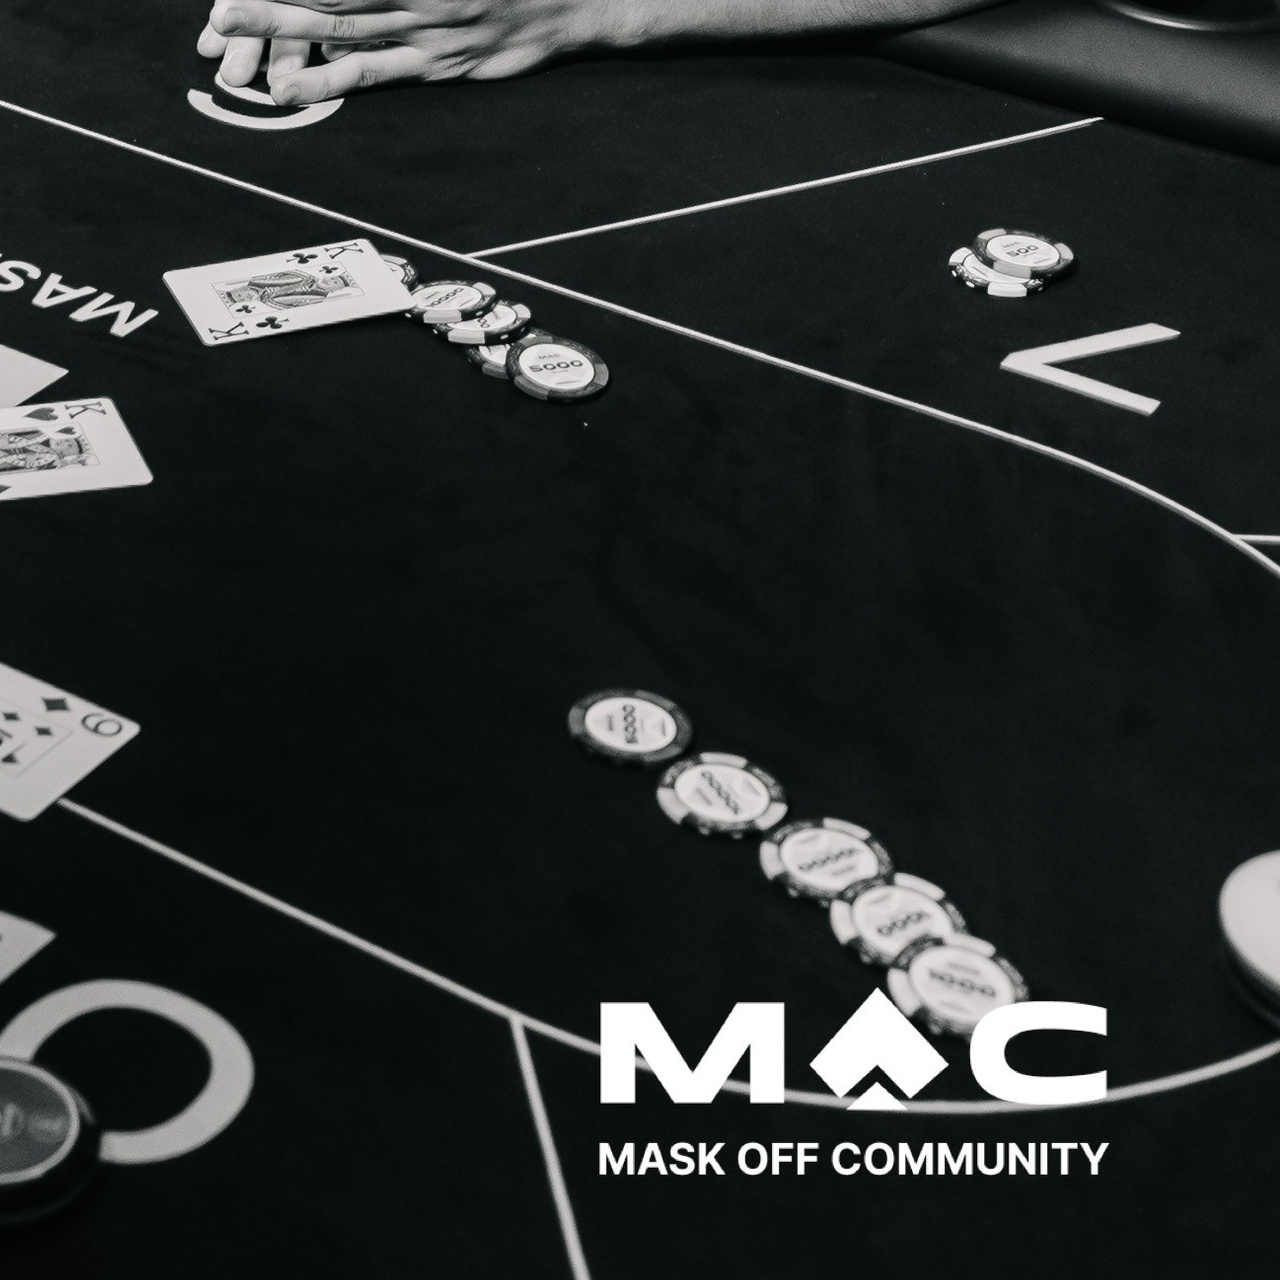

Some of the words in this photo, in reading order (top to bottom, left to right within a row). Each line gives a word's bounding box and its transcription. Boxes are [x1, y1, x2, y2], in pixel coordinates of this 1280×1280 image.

[324, 242, 364, 260] K
[207, 320, 249, 340] K
[529, 359, 584, 373] 5000
[64, 401, 107, 419] K
